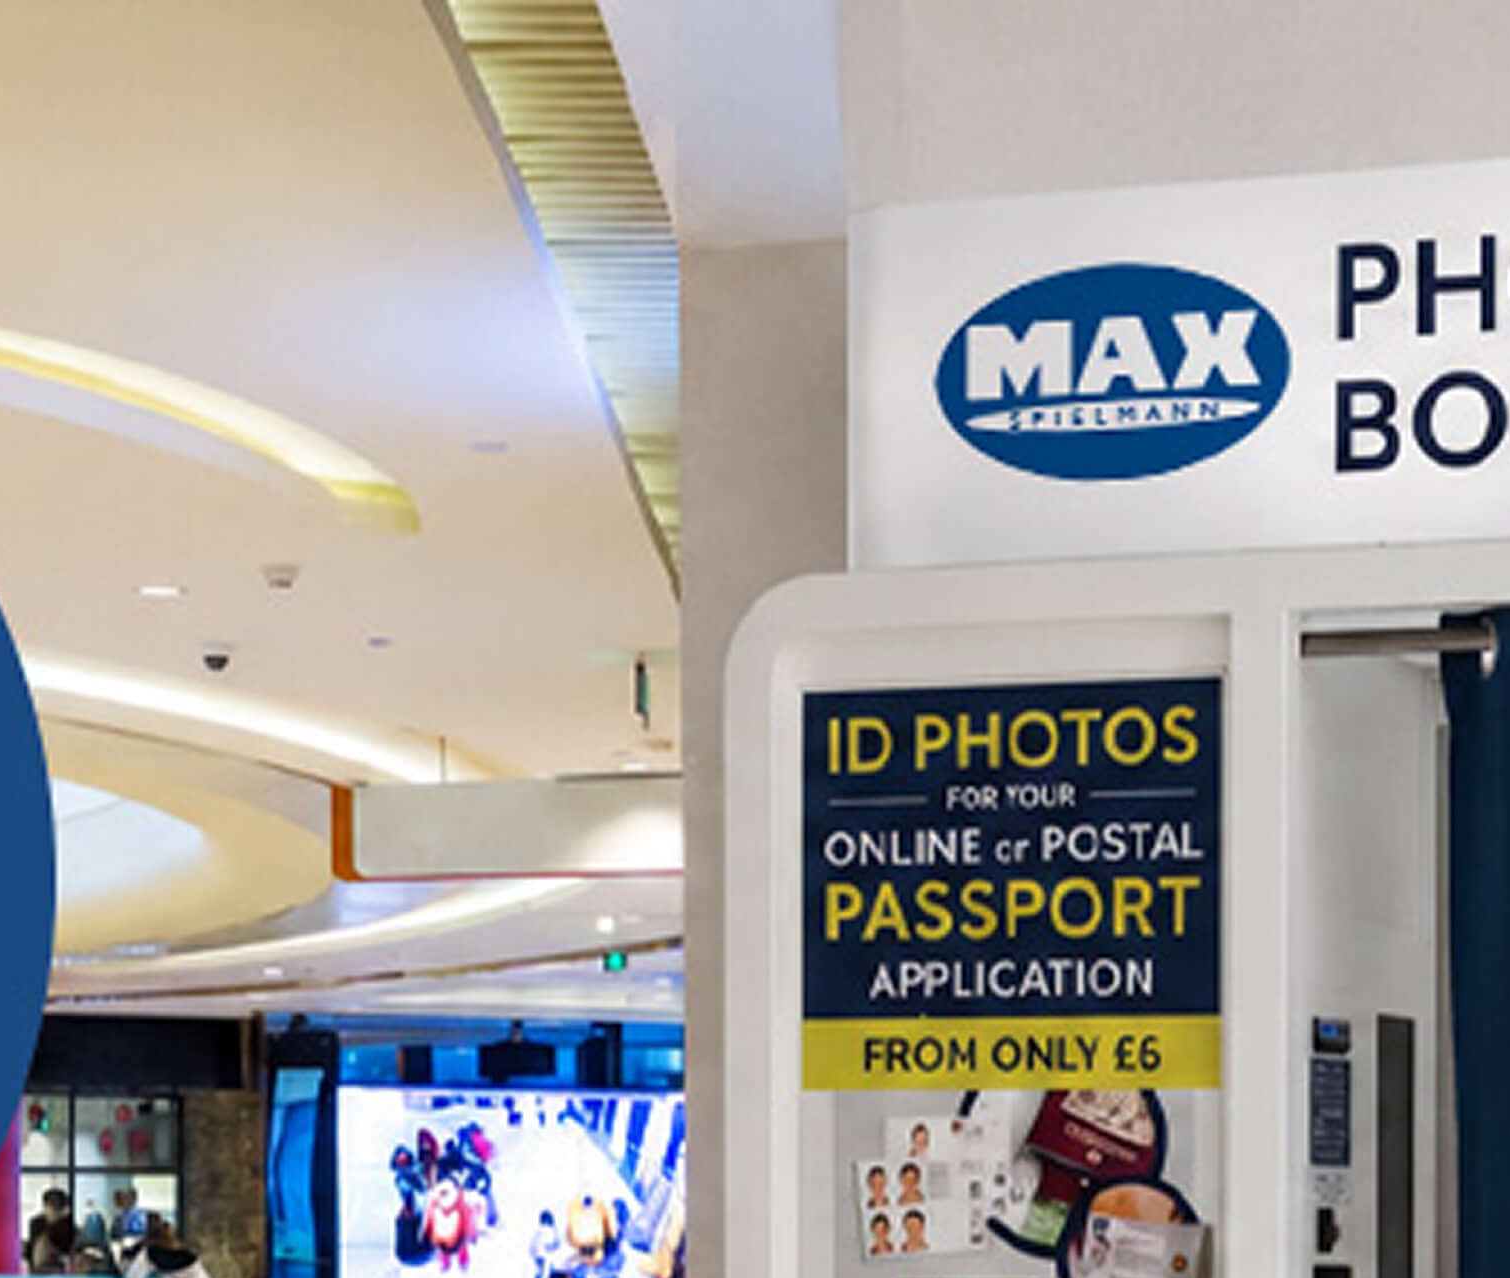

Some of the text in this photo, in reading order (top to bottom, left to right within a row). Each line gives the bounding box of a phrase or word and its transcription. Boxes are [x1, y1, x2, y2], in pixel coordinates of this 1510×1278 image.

[966, 310, 1262, 401] MAX
[1007, 401, 1222, 433] SPIELMANN
[827, 705, 1199, 774] ID PHOTOS
[946, 782, 1076, 811] FOR YOUR
[824, 822, 1203, 867] ONLINE or POSTAL
[825, 875, 1201, 941] PASSPORT
[869, 958, 1154, 999] APPLICATION
[863, 1034, 1162, 1073] FROM ONLY £6
